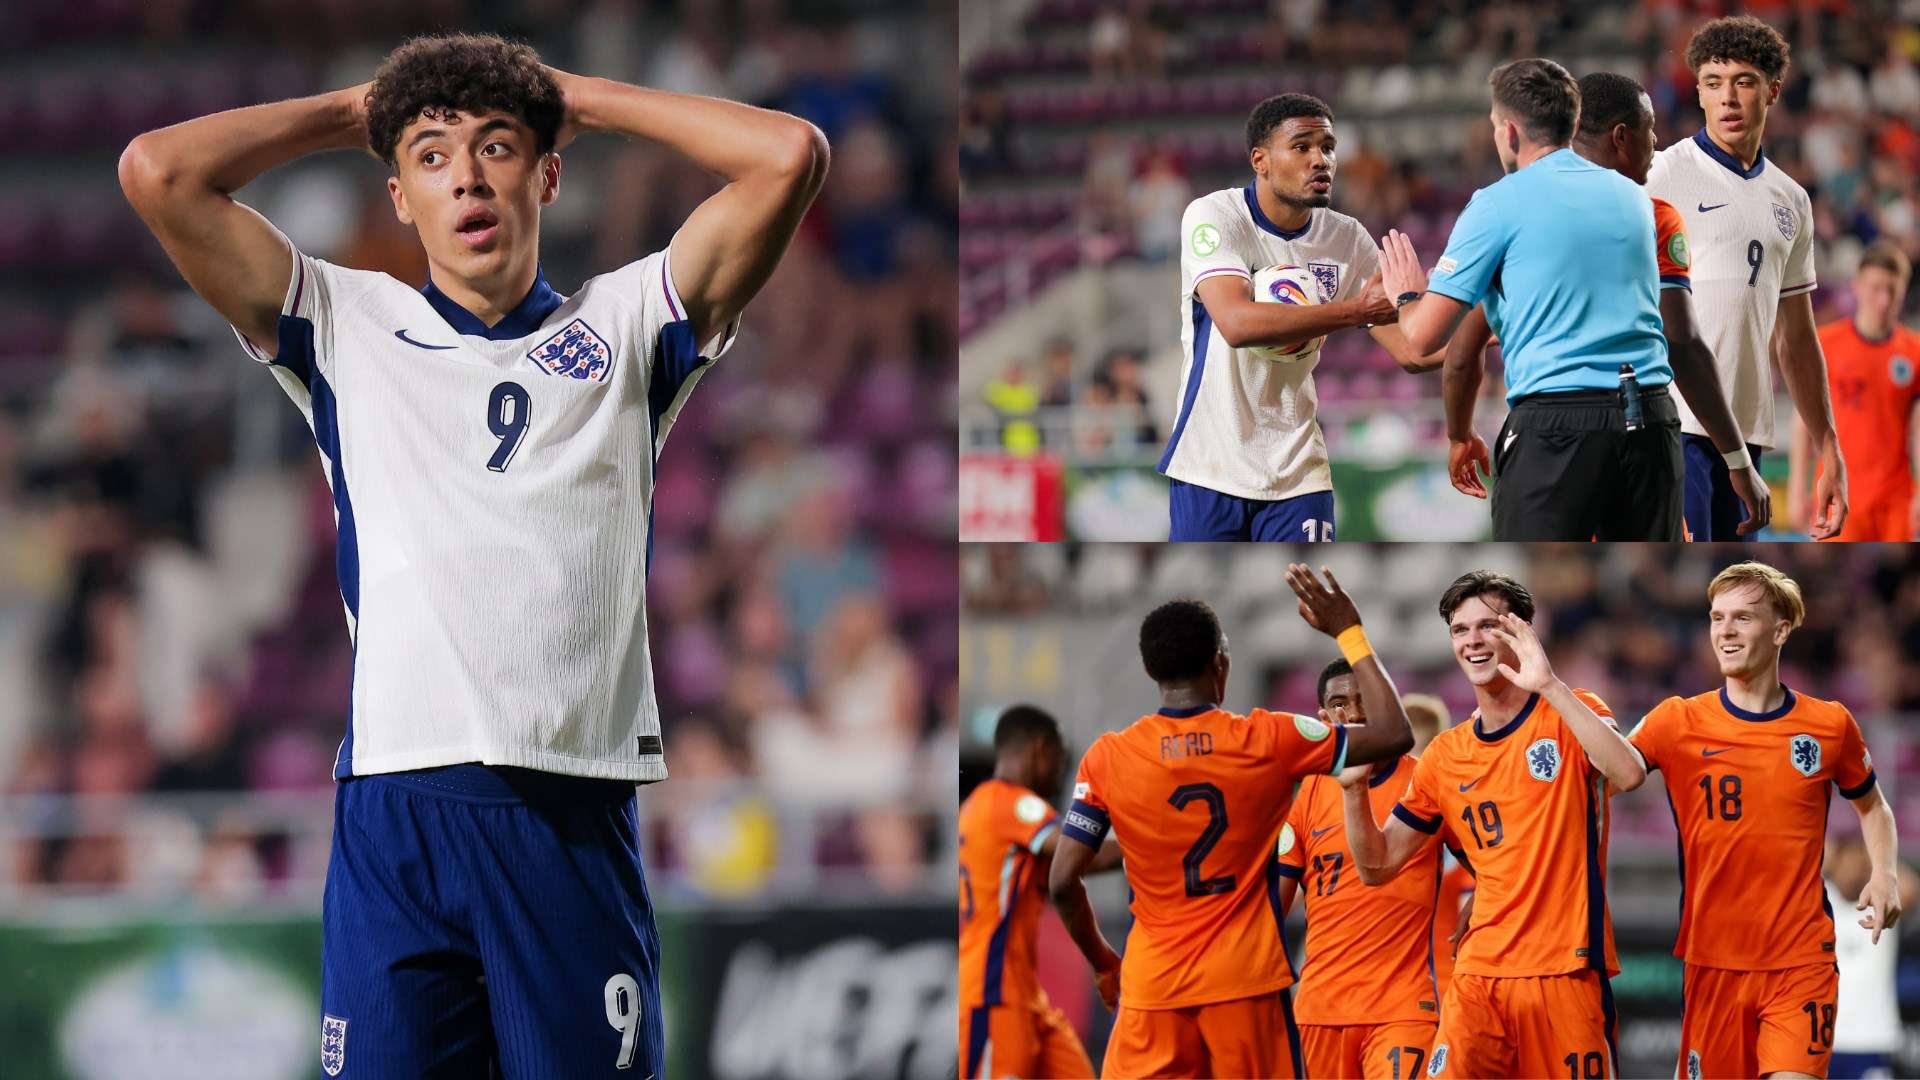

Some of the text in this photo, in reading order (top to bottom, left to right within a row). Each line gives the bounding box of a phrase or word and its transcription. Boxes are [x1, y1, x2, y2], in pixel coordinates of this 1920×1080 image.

[1747, 239, 1765, 288] 9
[486, 381, 532, 473] 9
[1160, 731, 1214, 760] READ
[1698, 774, 1742, 821] 18
[1068, 813, 1103, 834] RESPECT
[1167, 782, 1238, 898] 2
[1461, 800, 1504, 850] 19
[1313, 851, 1345, 897] 17
[604, 973, 642, 1070] 9
[1802, 1001, 1835, 1049] 18
[1387, 1045, 1425, 1080] 17
